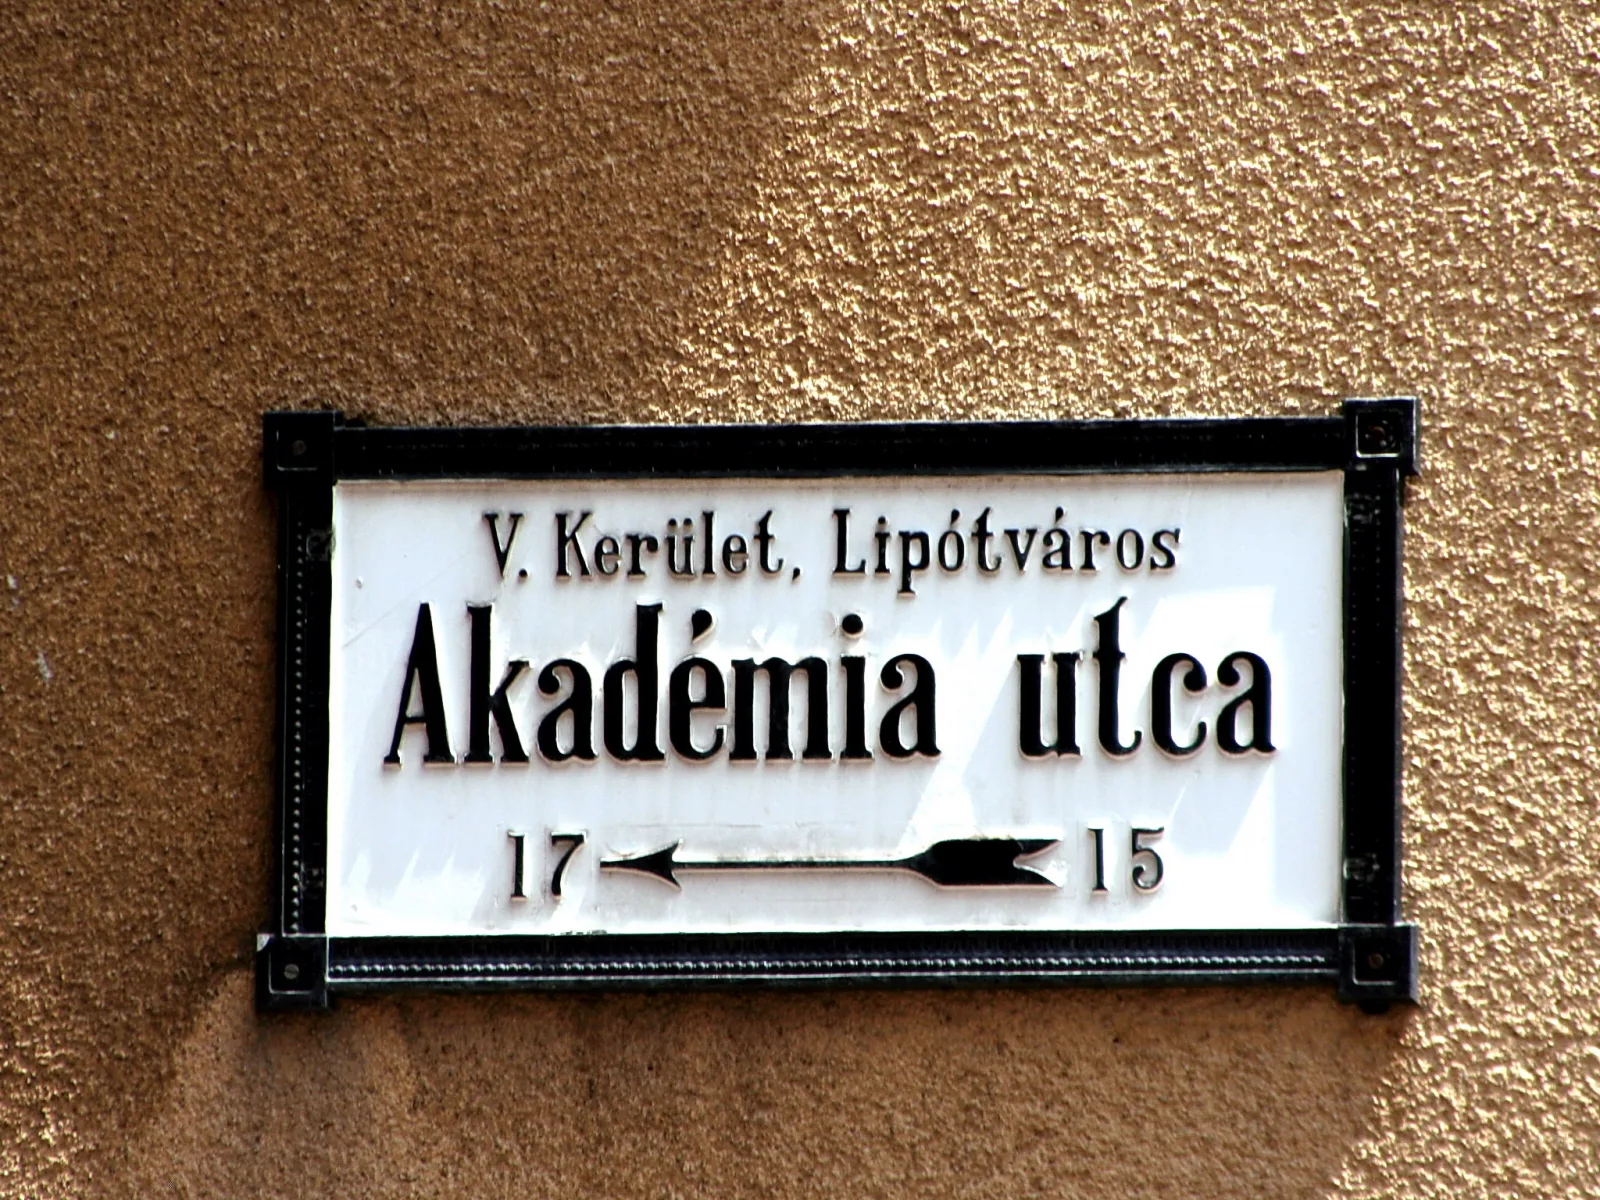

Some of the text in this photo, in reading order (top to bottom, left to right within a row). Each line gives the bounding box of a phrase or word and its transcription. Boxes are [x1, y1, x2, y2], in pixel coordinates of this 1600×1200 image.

[482, 506, 1180, 595] V. Kerület, Lipótváros
[383, 596, 1276, 765] Akadémia utca
[508, 827, 1165, 899] 17 15
